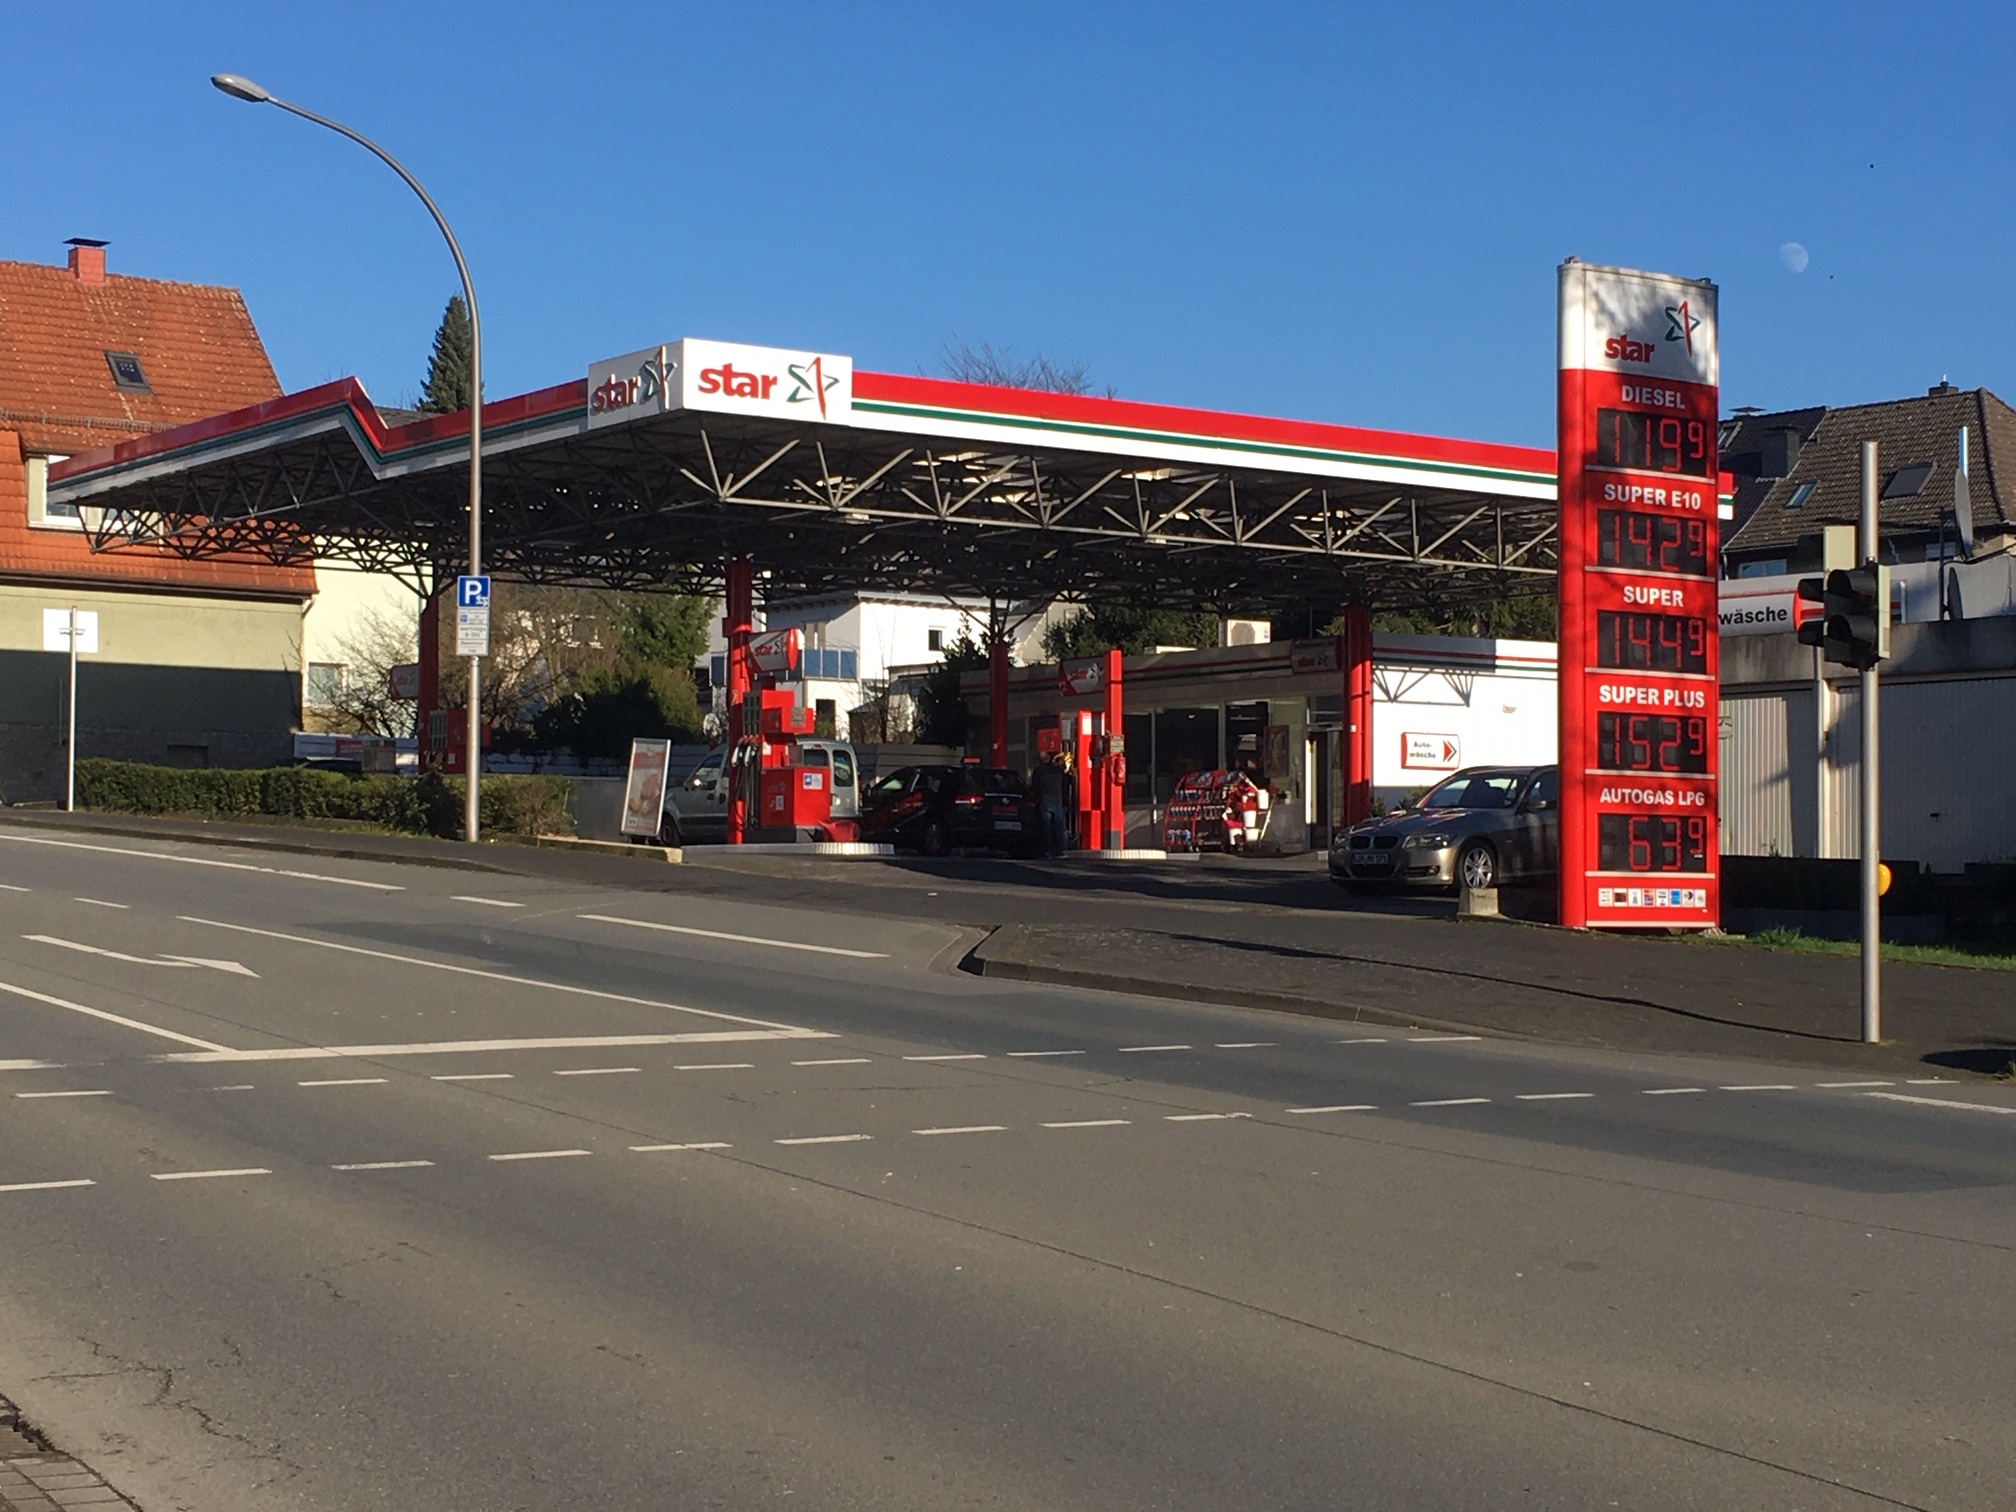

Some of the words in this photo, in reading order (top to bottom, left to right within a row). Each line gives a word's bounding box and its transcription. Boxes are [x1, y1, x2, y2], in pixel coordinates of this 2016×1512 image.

[1604, 334, 1655, 363] star
[591, 373, 641, 412] star
[698, 363, 778, 400] star
[1622, 385, 1685, 409] DIESEL
[1604, 483, 1666, 506] SUPER
[1671, 490, 1701, 510] E10
[465, 580, 482, 604] P
[1623, 586, 1684, 607] SUPER
[1599, 685, 1660, 705] SUPER
[1664, 689, 1705, 708] PLUS
[1600, 788, 1674, 805] AUTOGAS
[1678, 791, 1705, 806] LPG
